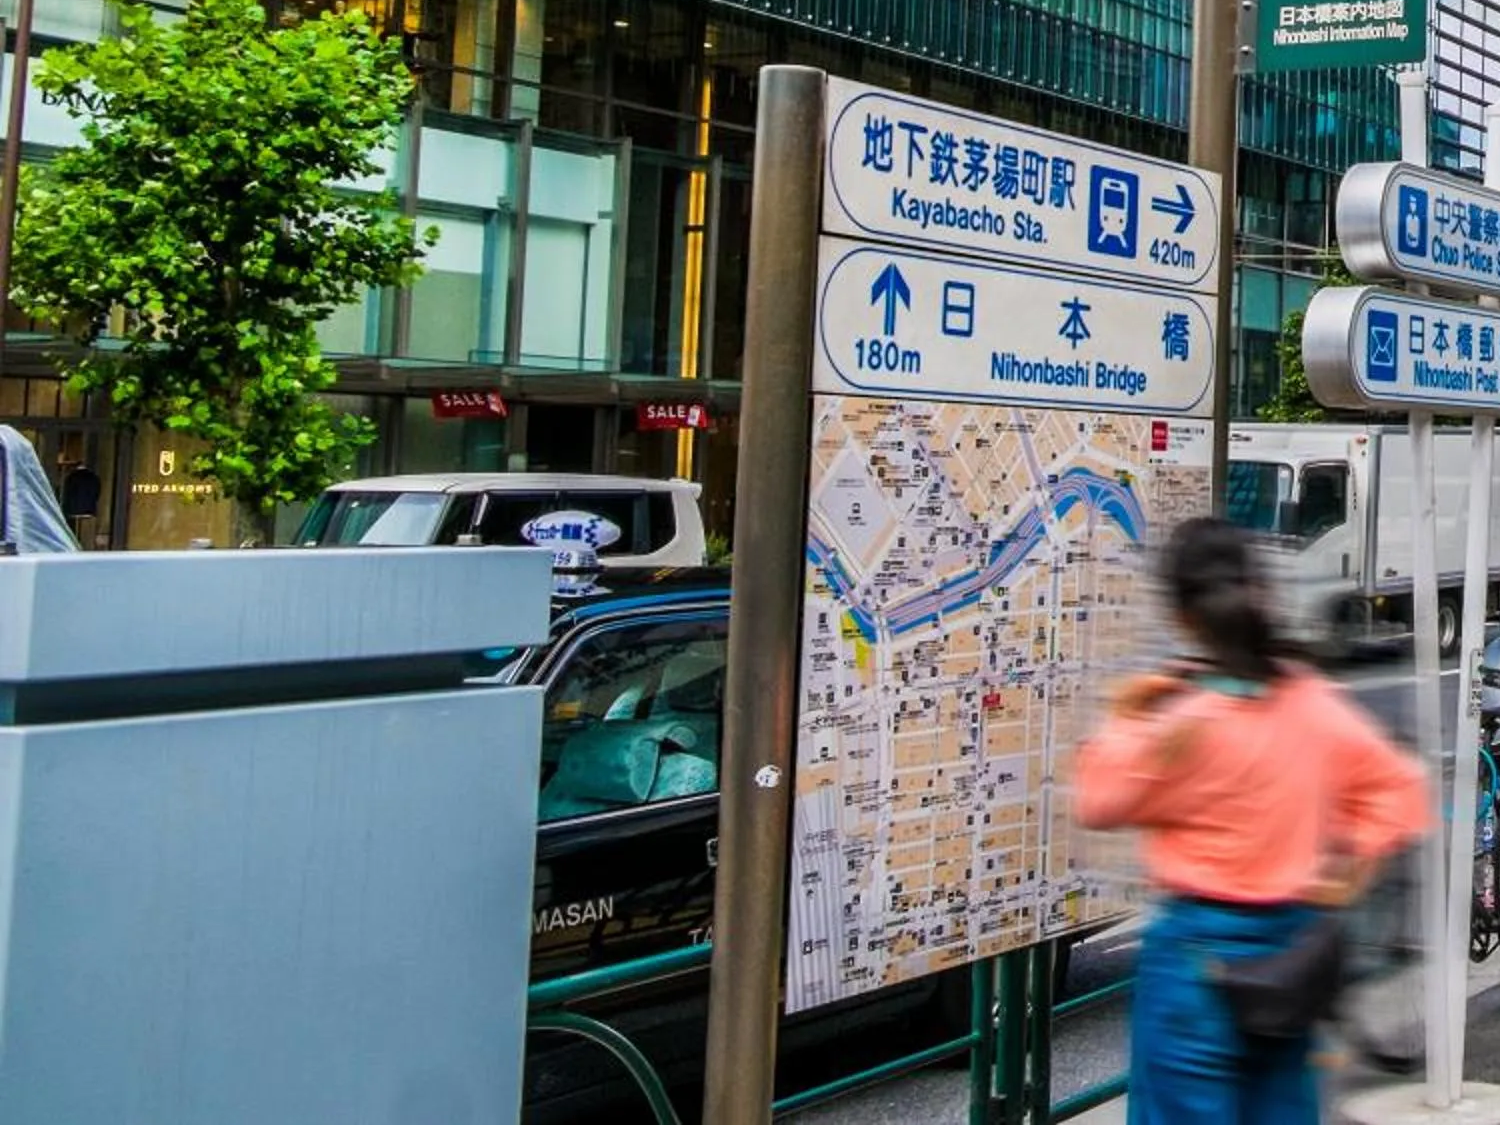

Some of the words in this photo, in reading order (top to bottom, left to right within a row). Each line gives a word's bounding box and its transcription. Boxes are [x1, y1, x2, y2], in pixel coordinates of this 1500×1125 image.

[1279, 0, 1405, 26] 日本橋案内地図
[1330, 22, 1384, 42] Information
[1386, 21, 1409, 42] Map
[861, 112, 1077, 211] 地下鉄茅場町駅
[891, 186, 1006, 237] Kayabacho
[1013, 210, 1049, 244] Sta.
[1149, 237, 1196, 270] 420m
[1432, 235, 1459, 267] Chuo
[1463, 242, 1493, 274] Police
[941, 279, 1191, 363] 日本橋
[853, 338, 923, 374] 180m
[990, 351, 1091, 389] Nihonbashi
[1095, 362, 1148, 396] Bridge
[1475, 366, 1498, 393] Post
[441, 394, 485, 407] SALE
[647, 404, 686, 419] SALE
